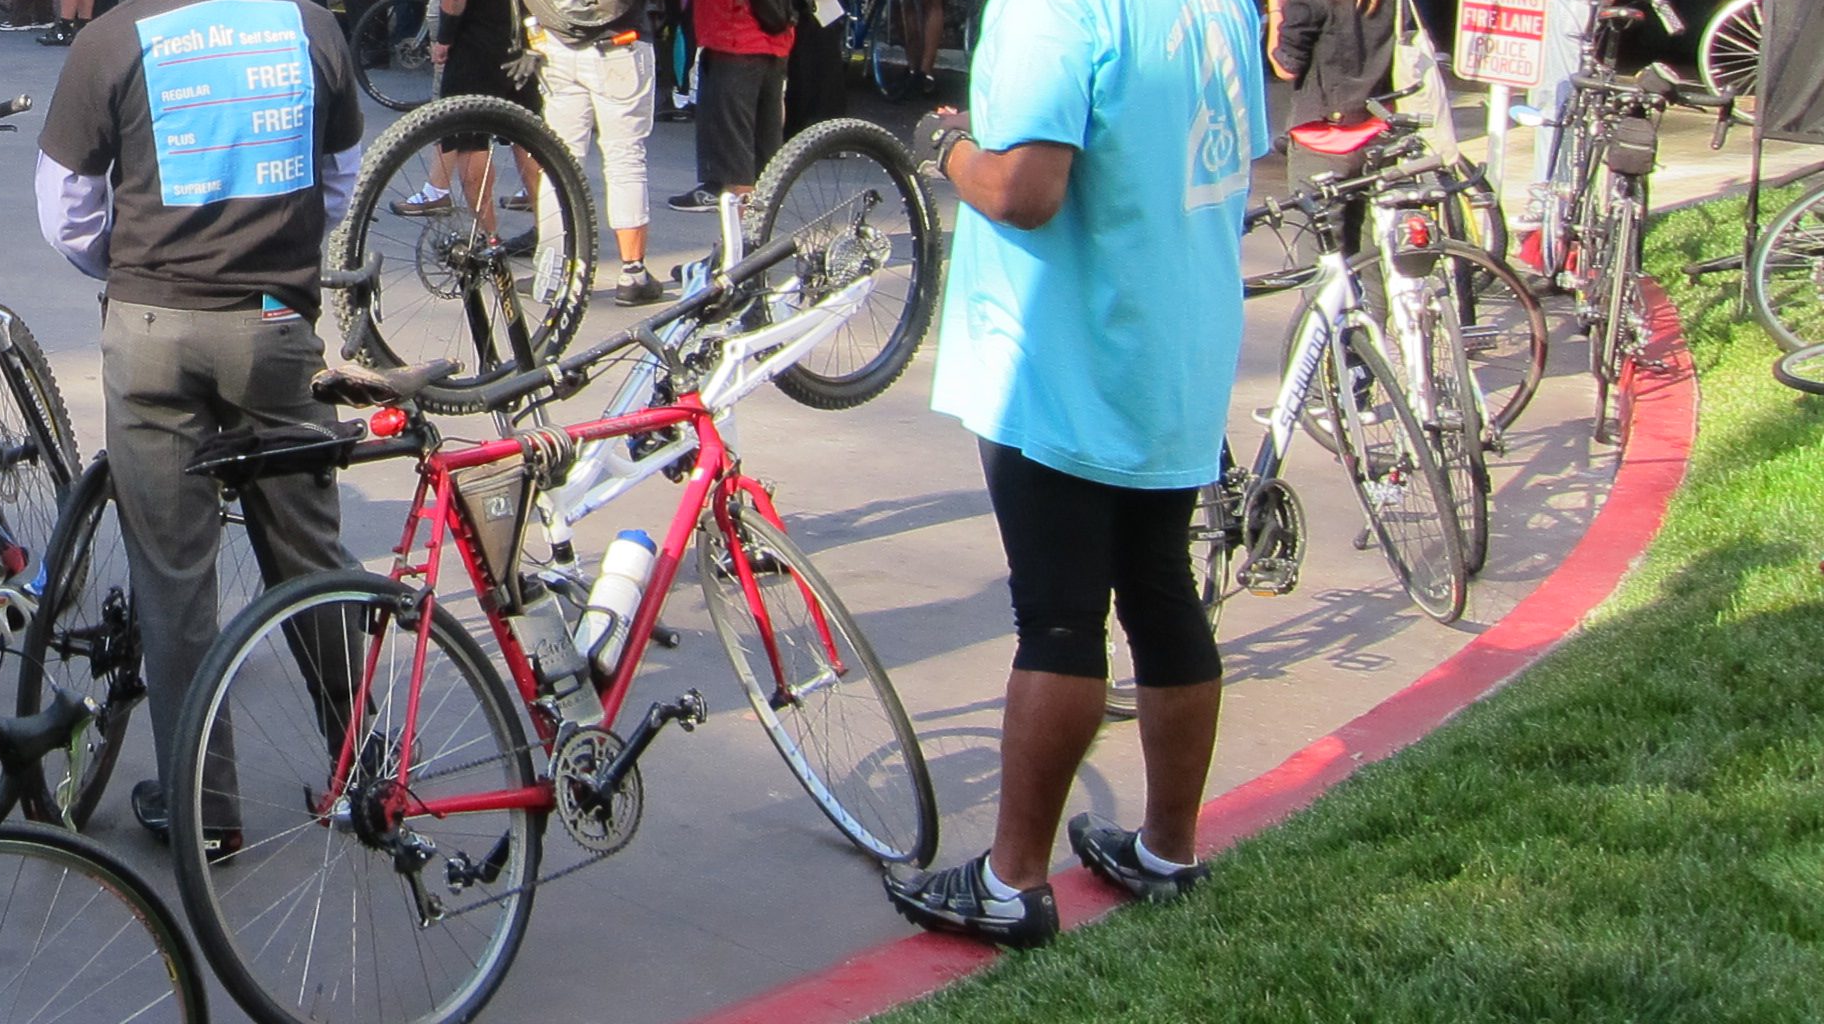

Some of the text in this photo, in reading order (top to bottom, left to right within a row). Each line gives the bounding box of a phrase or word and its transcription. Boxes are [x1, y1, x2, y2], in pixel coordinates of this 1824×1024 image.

[1463, 7, 1542, 34] FIRE LANE
[151, 24, 297, 58] Fresh Air Self Serve
[1476, 36, 1528, 59] POLICE
[246, 62, 303, 91] FREE
[1466, 52, 1533, 77] ENFORCED
[161, 84, 211, 102] REGULAR
[252, 104, 305, 134] FREE
[167, 133, 196, 146] PLUS
[256, 155, 305, 185] FREE
[173, 179, 222, 196] SUPREME
